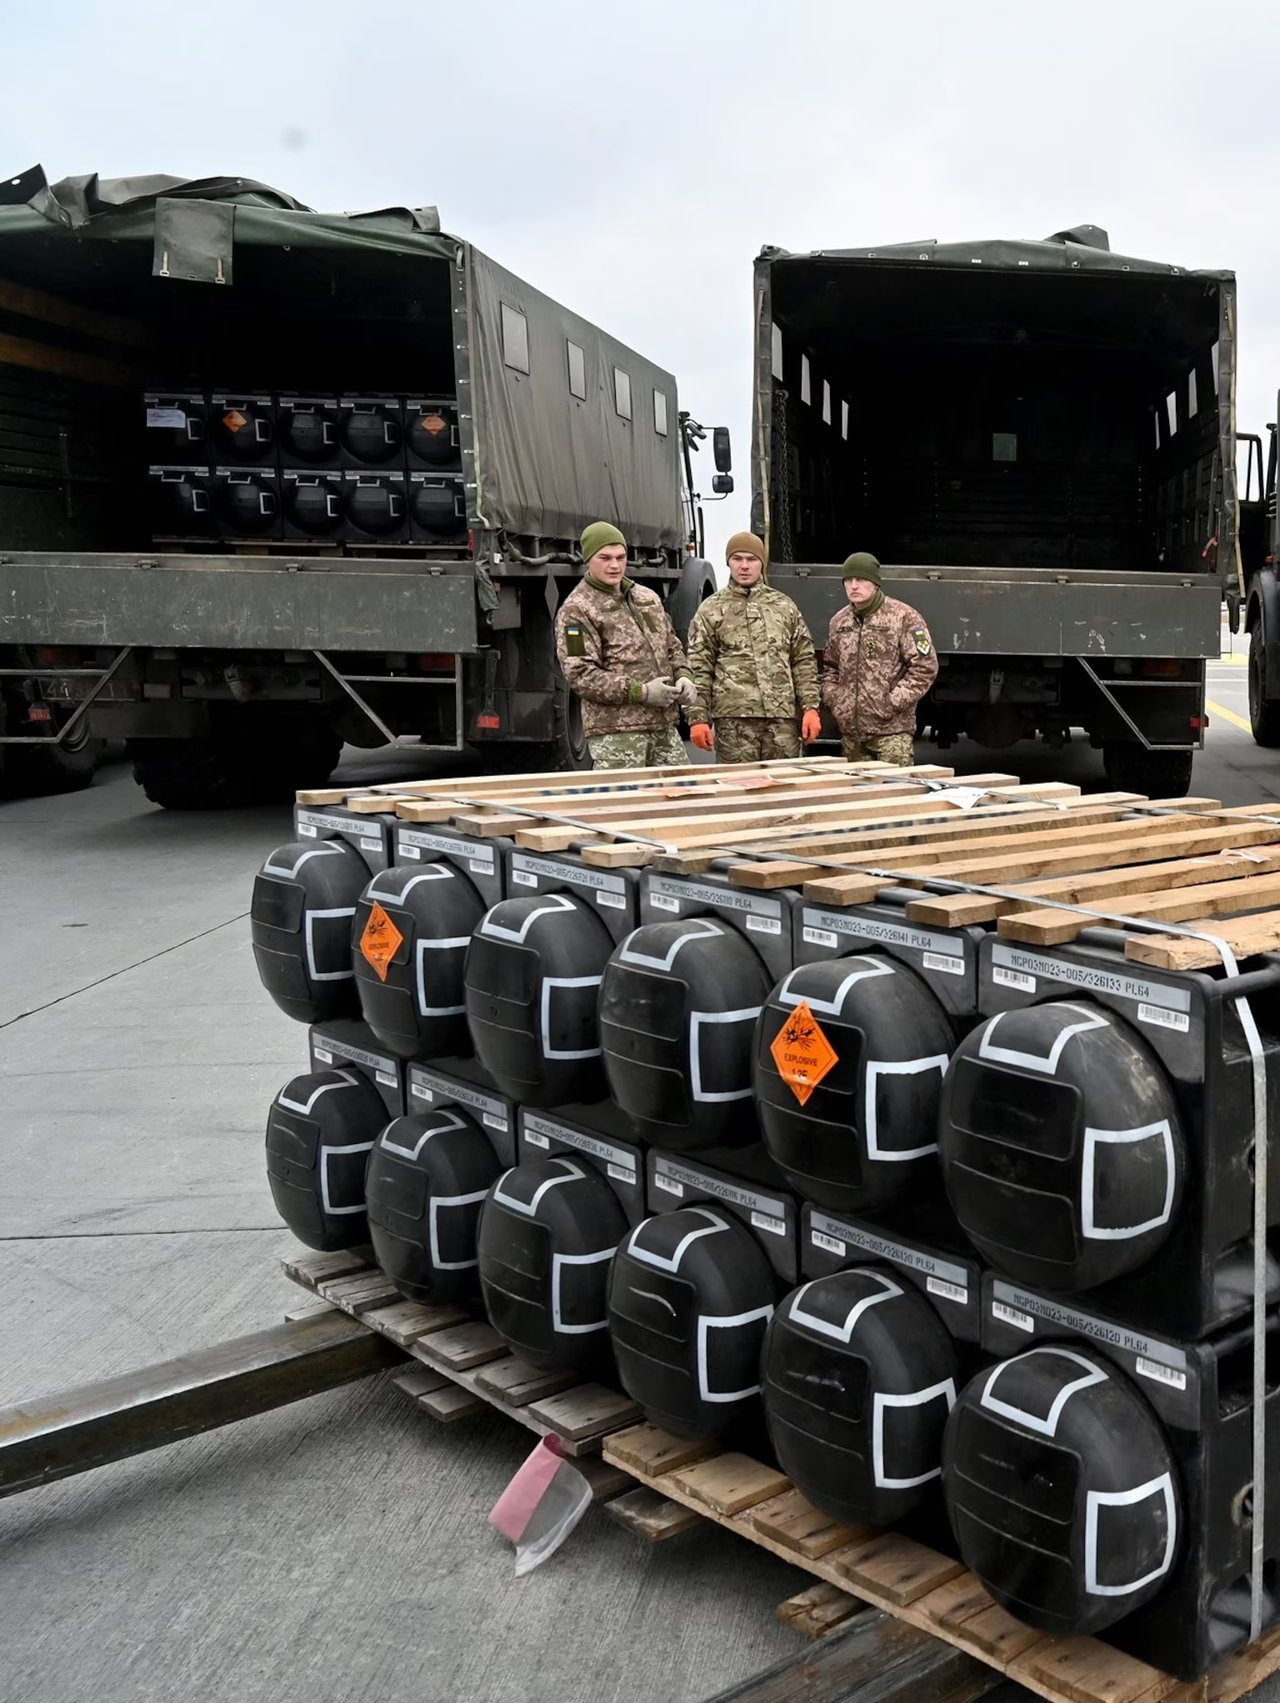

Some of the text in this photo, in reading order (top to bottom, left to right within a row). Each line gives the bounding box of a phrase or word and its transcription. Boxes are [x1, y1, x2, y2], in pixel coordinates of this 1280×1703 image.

[735, 897, 752, 910] PL64
[911, 935, 931, 948] PL64
[1125, 982, 1149, 998] PL64
[785, 1053, 818, 1067] EXPLOSIVE
[916, 1257, 935, 1273] PL64
[1124, 1336, 1148, 1353] PL64
